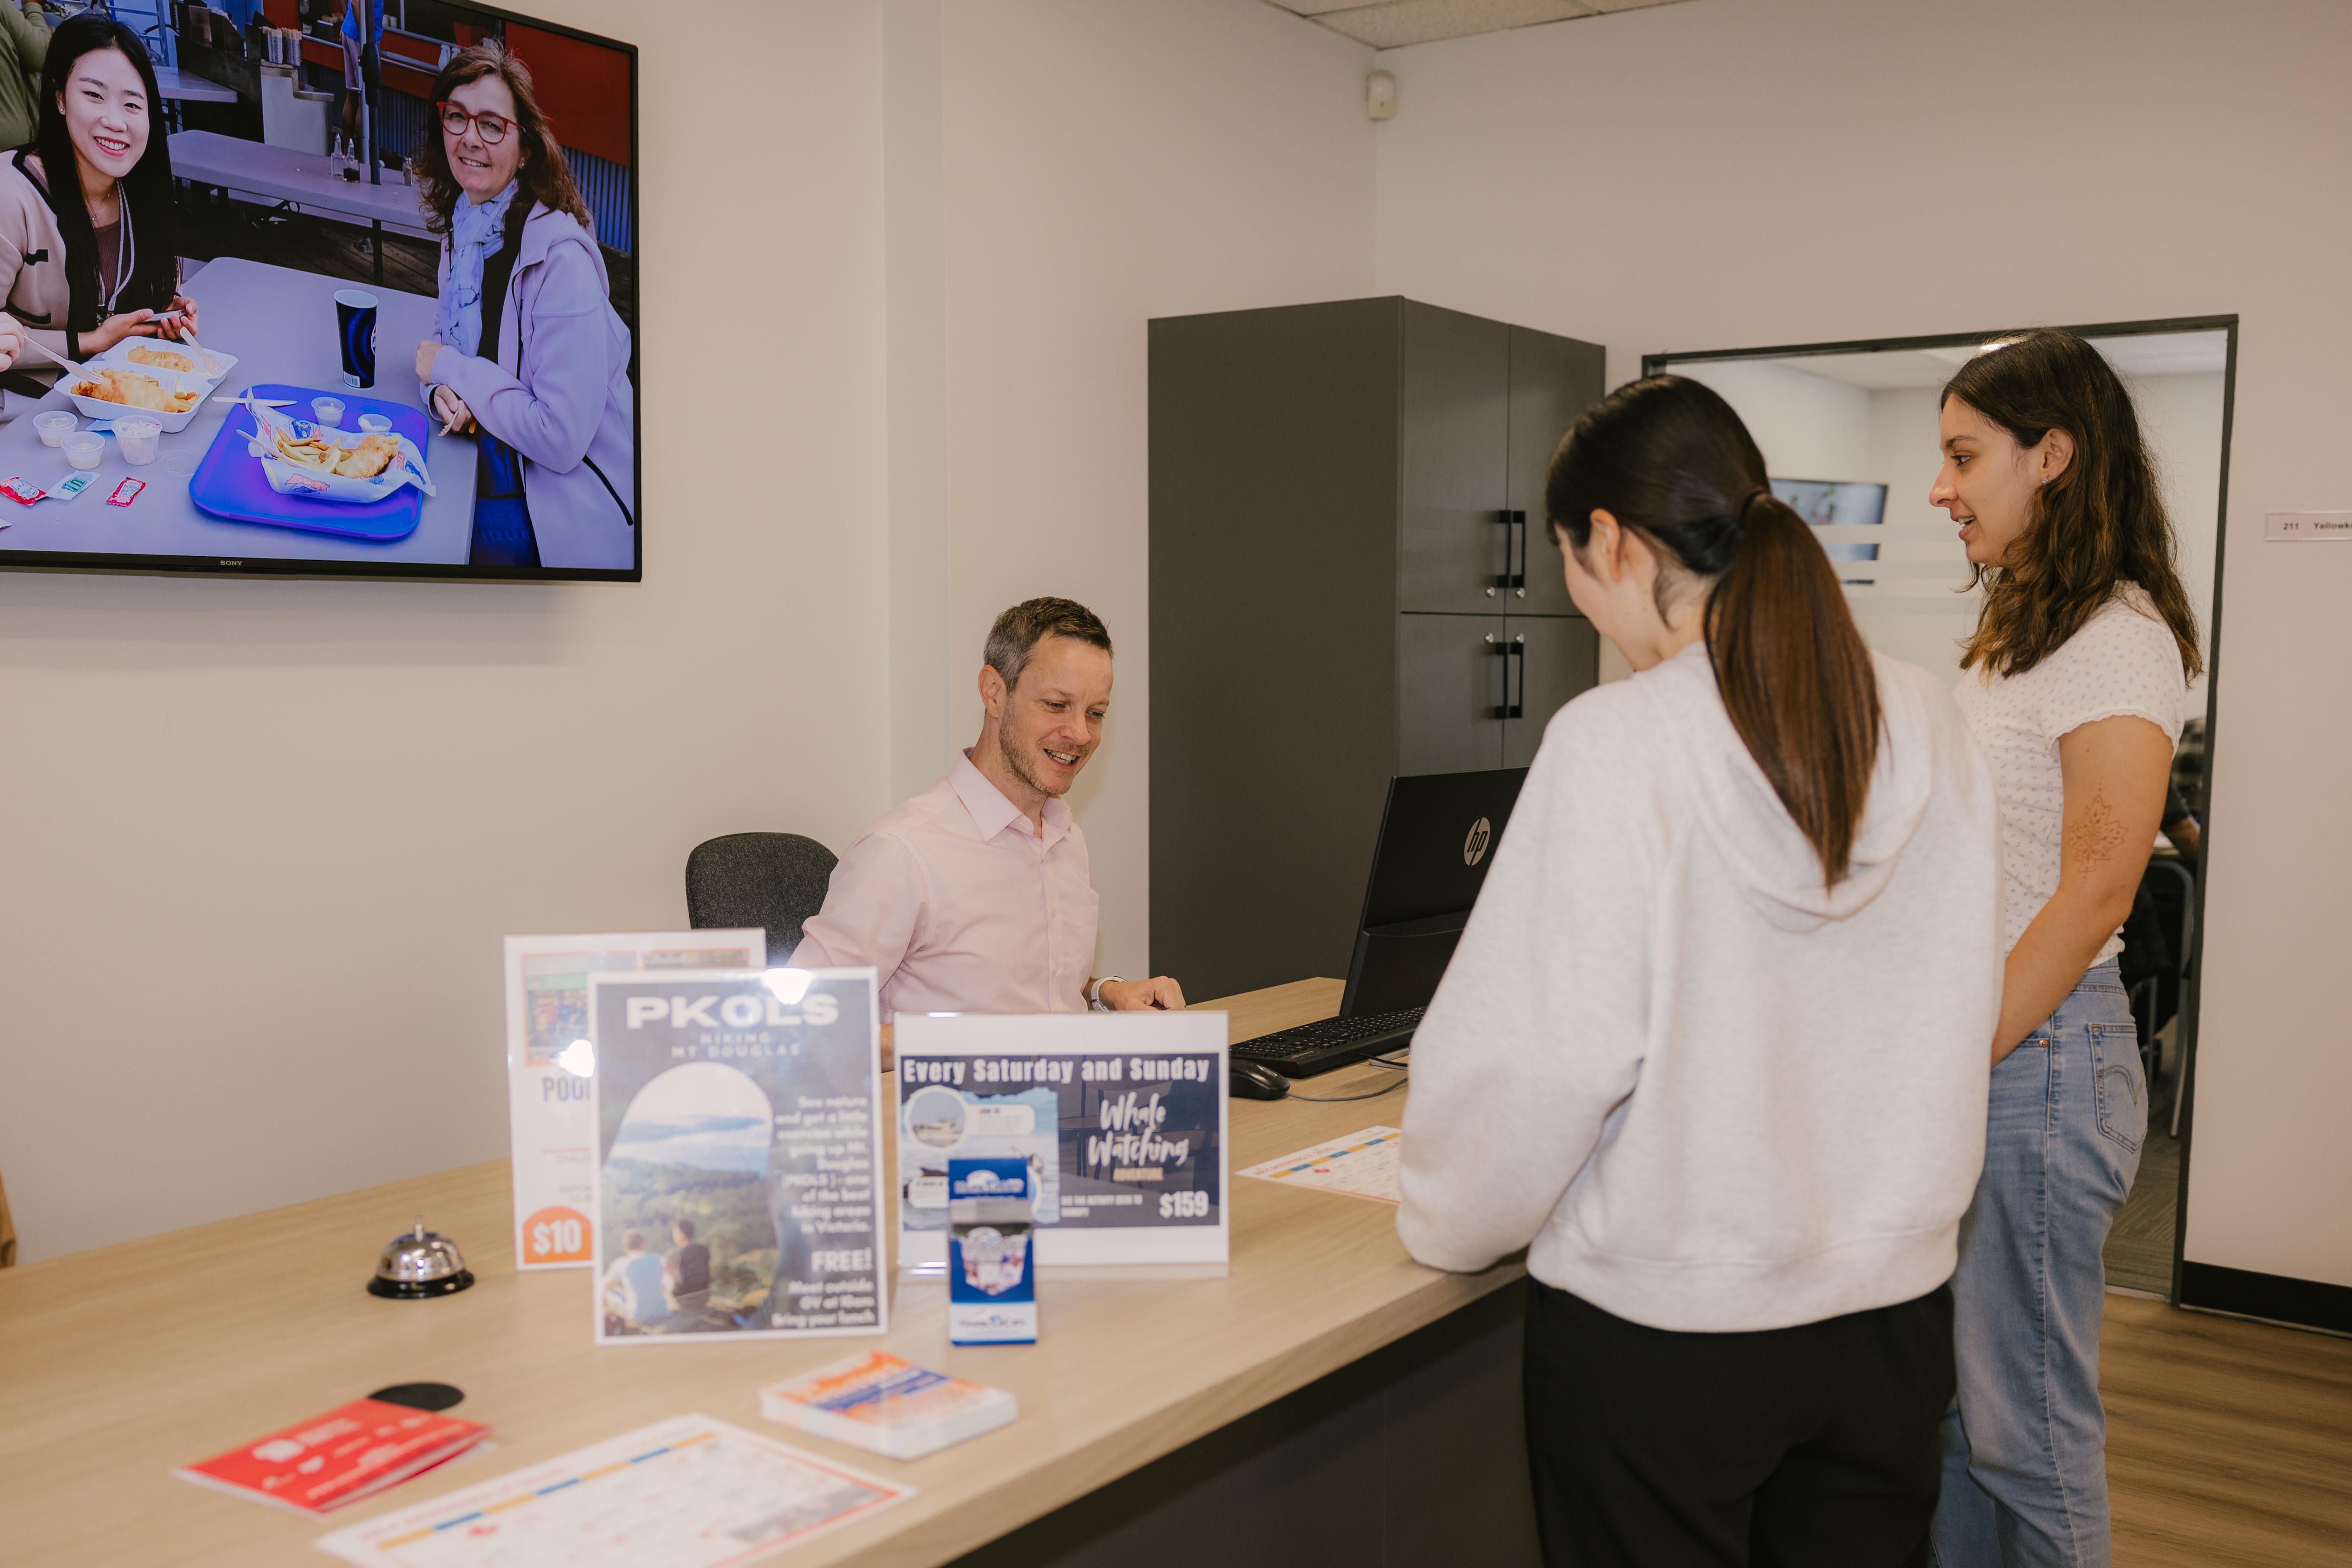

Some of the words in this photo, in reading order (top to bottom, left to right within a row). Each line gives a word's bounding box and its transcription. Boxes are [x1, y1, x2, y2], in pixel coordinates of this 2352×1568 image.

[2283, 522, 2299, 530] 211
[2313, 521, 2352, 530] Yellowk
[1465, 817, 1489, 866] hp
[627, 994, 839, 1028] PKOLS
[671, 1045, 697, 1058] MT
[708, 1044, 800, 1058] DOUGLAS
[700, 1031, 770, 1045] HIKING
[904, 1059, 965, 1084] Every
[974, 1058, 1073, 1084] Saturday
[1082, 1058, 1122, 1081] and
[1130, 1057, 1209, 1082] Sunday
[1101, 1092, 1166, 1130] Whale
[1088, 1128, 1189, 1166] Watching
[1159, 1191, 1208, 1219] $159
[533, 1219, 582, 1256] $10
[812, 1247, 872, 1272] FREE!
